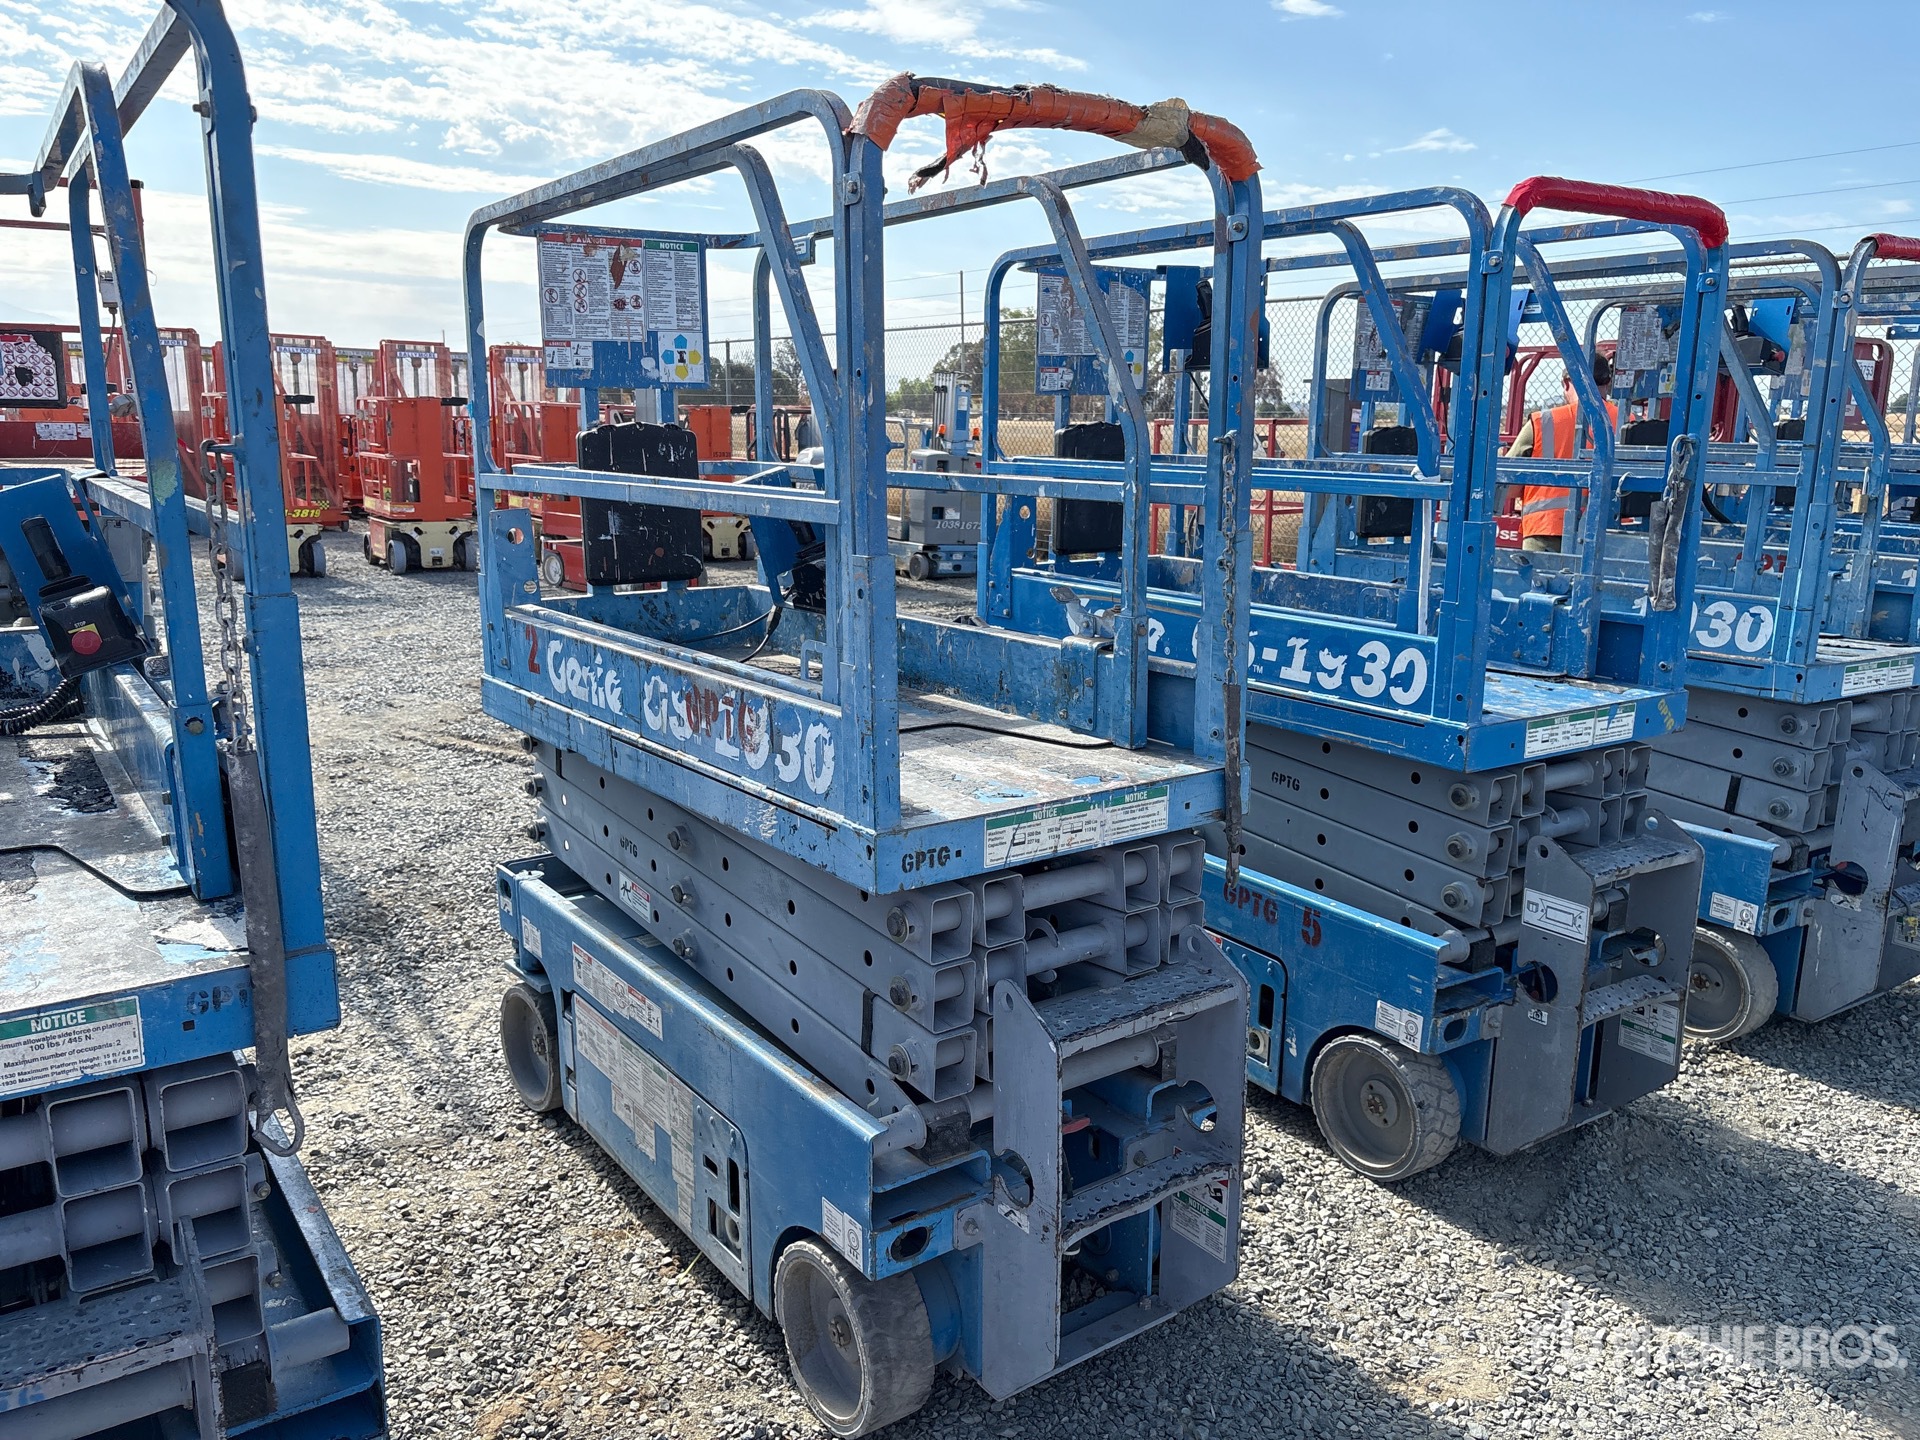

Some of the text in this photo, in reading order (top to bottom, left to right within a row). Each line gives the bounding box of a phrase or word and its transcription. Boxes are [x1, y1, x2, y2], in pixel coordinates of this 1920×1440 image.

[659, 242, 685, 250] NOTICE
[278, 346, 319, 354] BALLYMORE
[397, 351, 437, 359] BALLYMORE
[1496, 525, 1519, 541] SE
[74, 620, 87, 629] STOP
[1690, 600, 1774, 653] 30
[525, 623, 541, 675] 2
[1271, 770, 1301, 791] GPTG
[1124, 791, 1148, 803] NOTICE
[1033, 808, 1058, 820] NOTICE
[620, 836, 638, 858] GPTG
[901, 845, 951, 874] GPTG
[1223, 880, 1322, 948] GPTG 5
[30, 1010, 86, 1033] NOTICE
[22, 1032, 57, 1047] allowable
[57, 1030, 72, 1039] side
[72, 1026, 91, 1037] force
[30, 1043, 46, 1052] 100
[47, 1040, 61, 1049] lbs
[67, 1035, 83, 1044] 445
[84, 1033, 95, 1041] N.
[3, 1056, 40, 1069] Maximum
[40, 1051, 67, 1062] number
[17, 1066, 49, 1077] Maximum
[50, 1060, 78, 1070] Platform
[18, 1074, 50, 1084] Maximum
[1189, 1197, 1210, 1217] NOTICE
